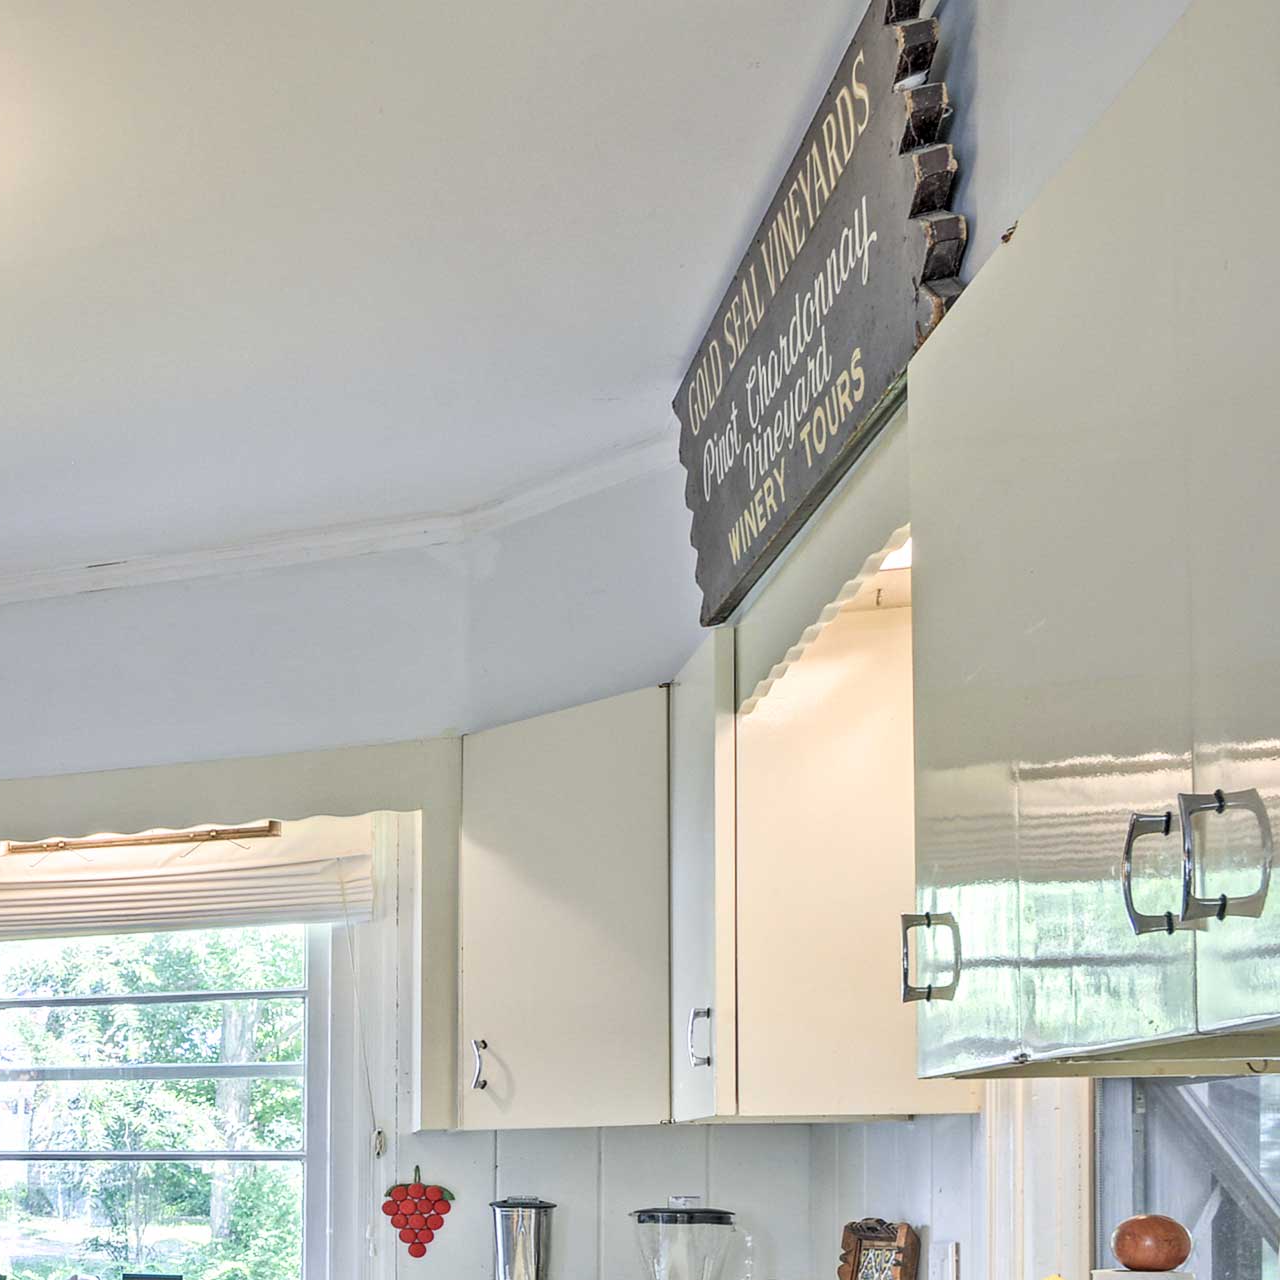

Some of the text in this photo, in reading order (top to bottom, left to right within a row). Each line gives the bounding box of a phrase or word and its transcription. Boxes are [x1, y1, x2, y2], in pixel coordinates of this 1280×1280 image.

[688, 48, 871, 437] GOLD SEAL VINEYARDS
[703, 195, 877, 502] Pinot Chardonnay
[728, 347, 865, 565] WINERY TOURS
